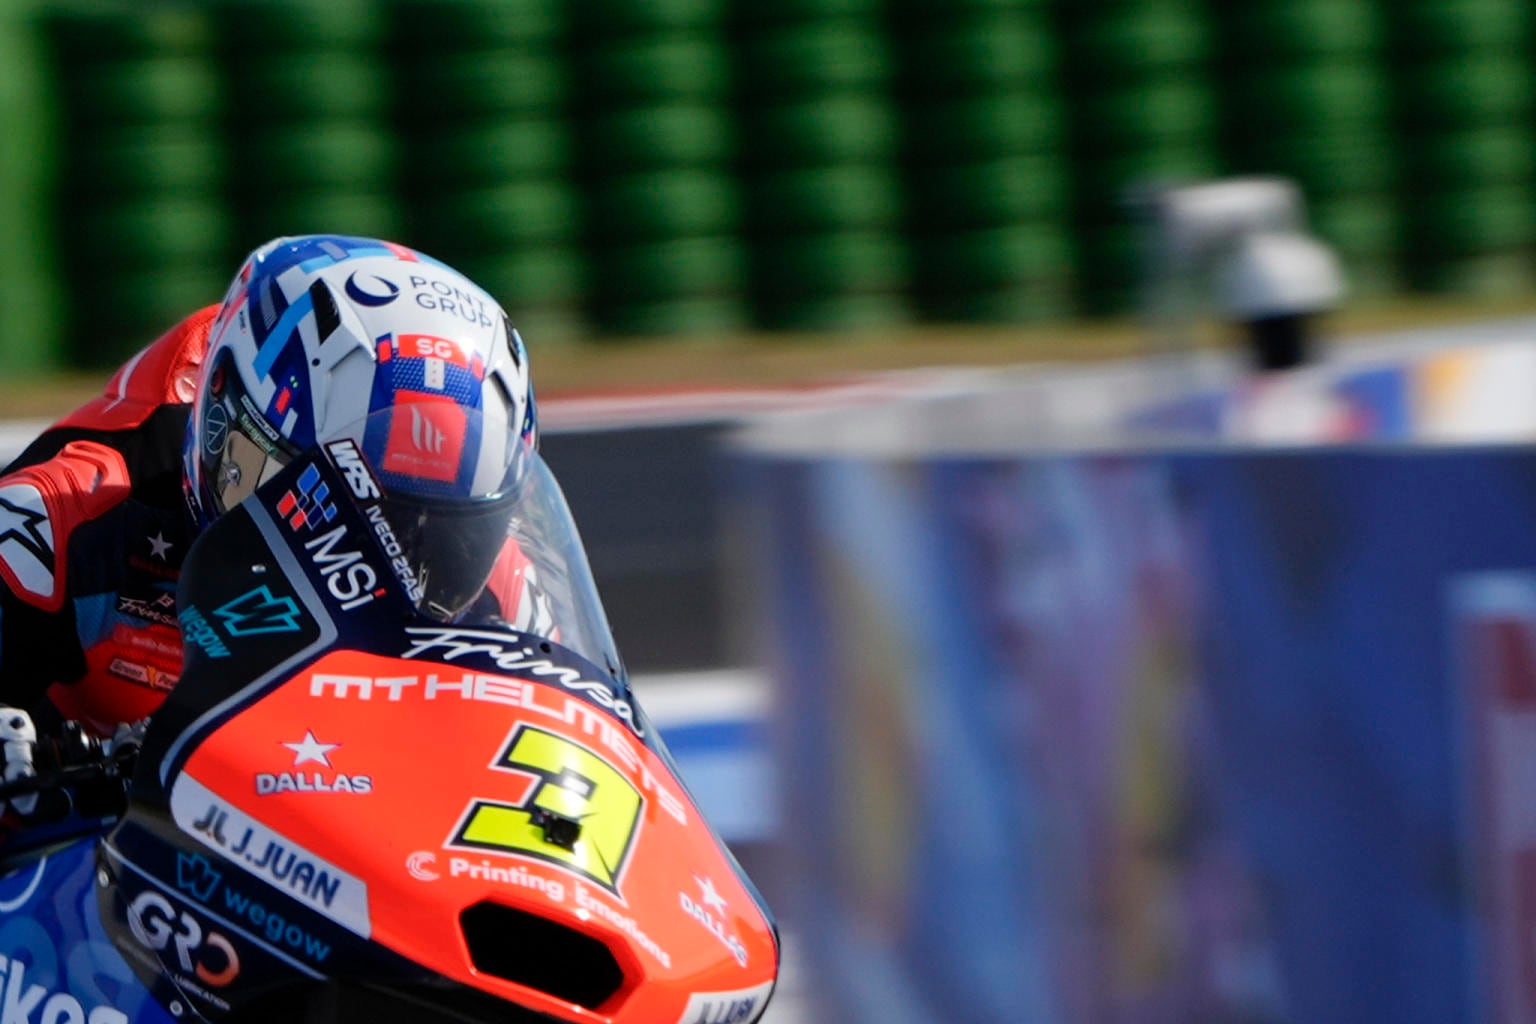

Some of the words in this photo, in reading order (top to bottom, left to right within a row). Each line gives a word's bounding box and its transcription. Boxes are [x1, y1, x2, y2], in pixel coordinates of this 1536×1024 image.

[409, 275, 488, 311] PONT
[415, 292, 493, 328] GRUP
[415, 337, 454, 359] SG
[327, 439, 381, 500] WRS
[178, 603, 232, 659] wegow
[400, 626, 645, 738] Frinsa
[255, 772, 373, 795] DALLAS
[309, 673, 418, 701] MT
[423, 673, 688, 827] HELMETS
[443, 719, 648, 903] 3
[231, 826, 341, 909] J.JUAN
[224, 884, 332, 962] wegow
[448, 856, 565, 903] Printing
[573, 884, 672, 969] Emotions
